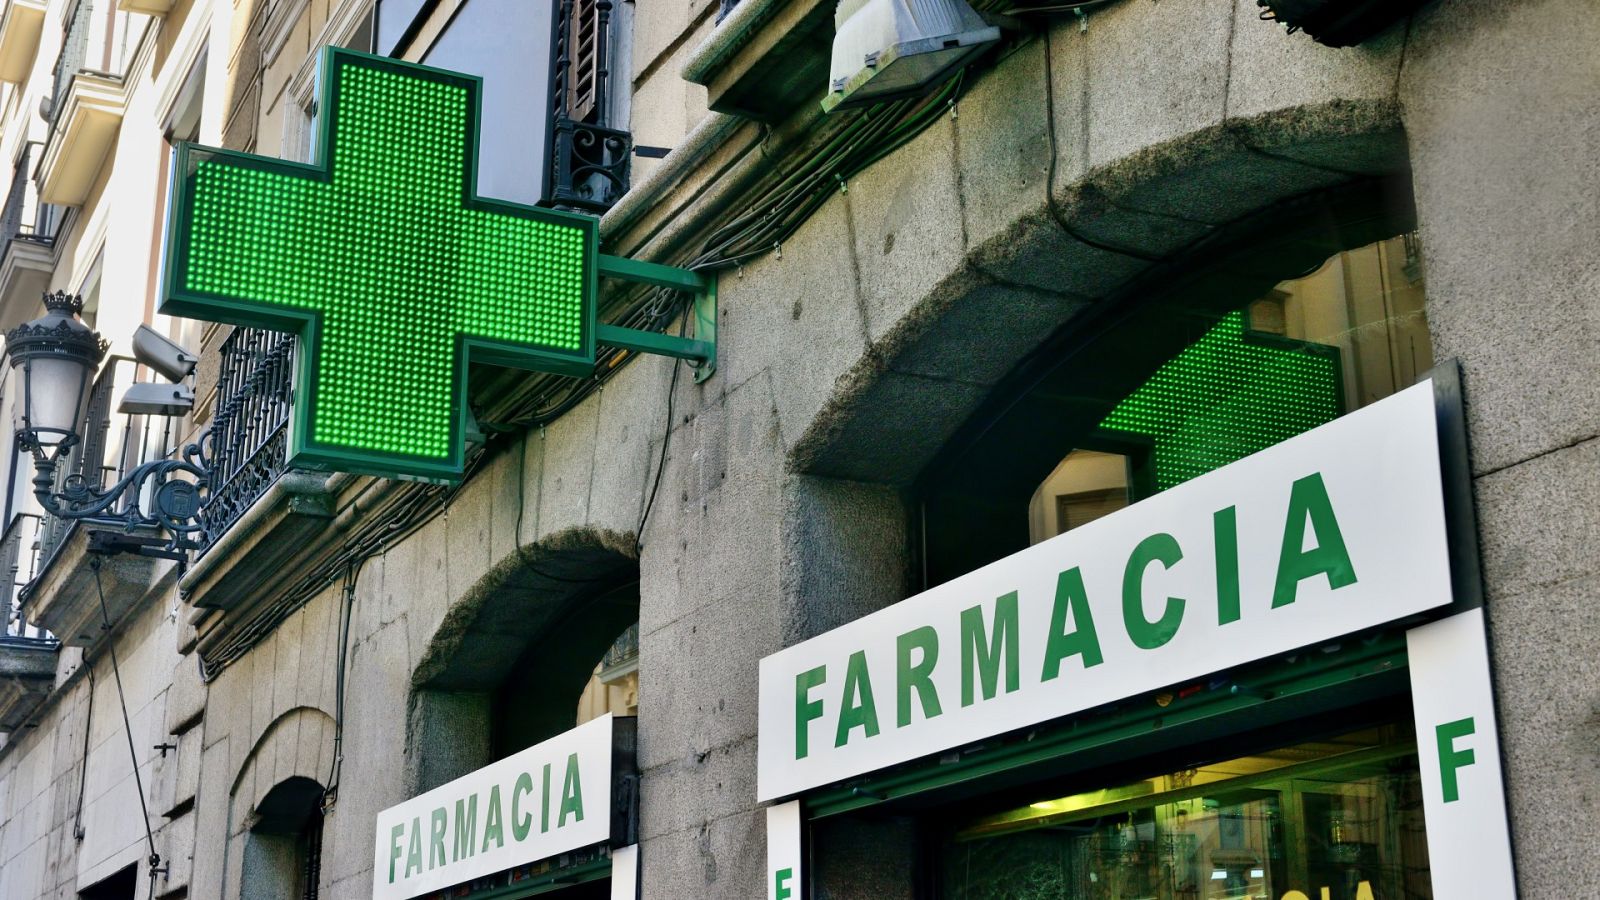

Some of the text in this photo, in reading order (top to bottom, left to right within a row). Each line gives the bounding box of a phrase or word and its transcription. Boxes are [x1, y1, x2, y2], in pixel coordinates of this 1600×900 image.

[795, 471, 1357, 760] FARMACIA
[389, 752, 585, 884] FARMACIA
[1436, 717, 1476, 803] F
